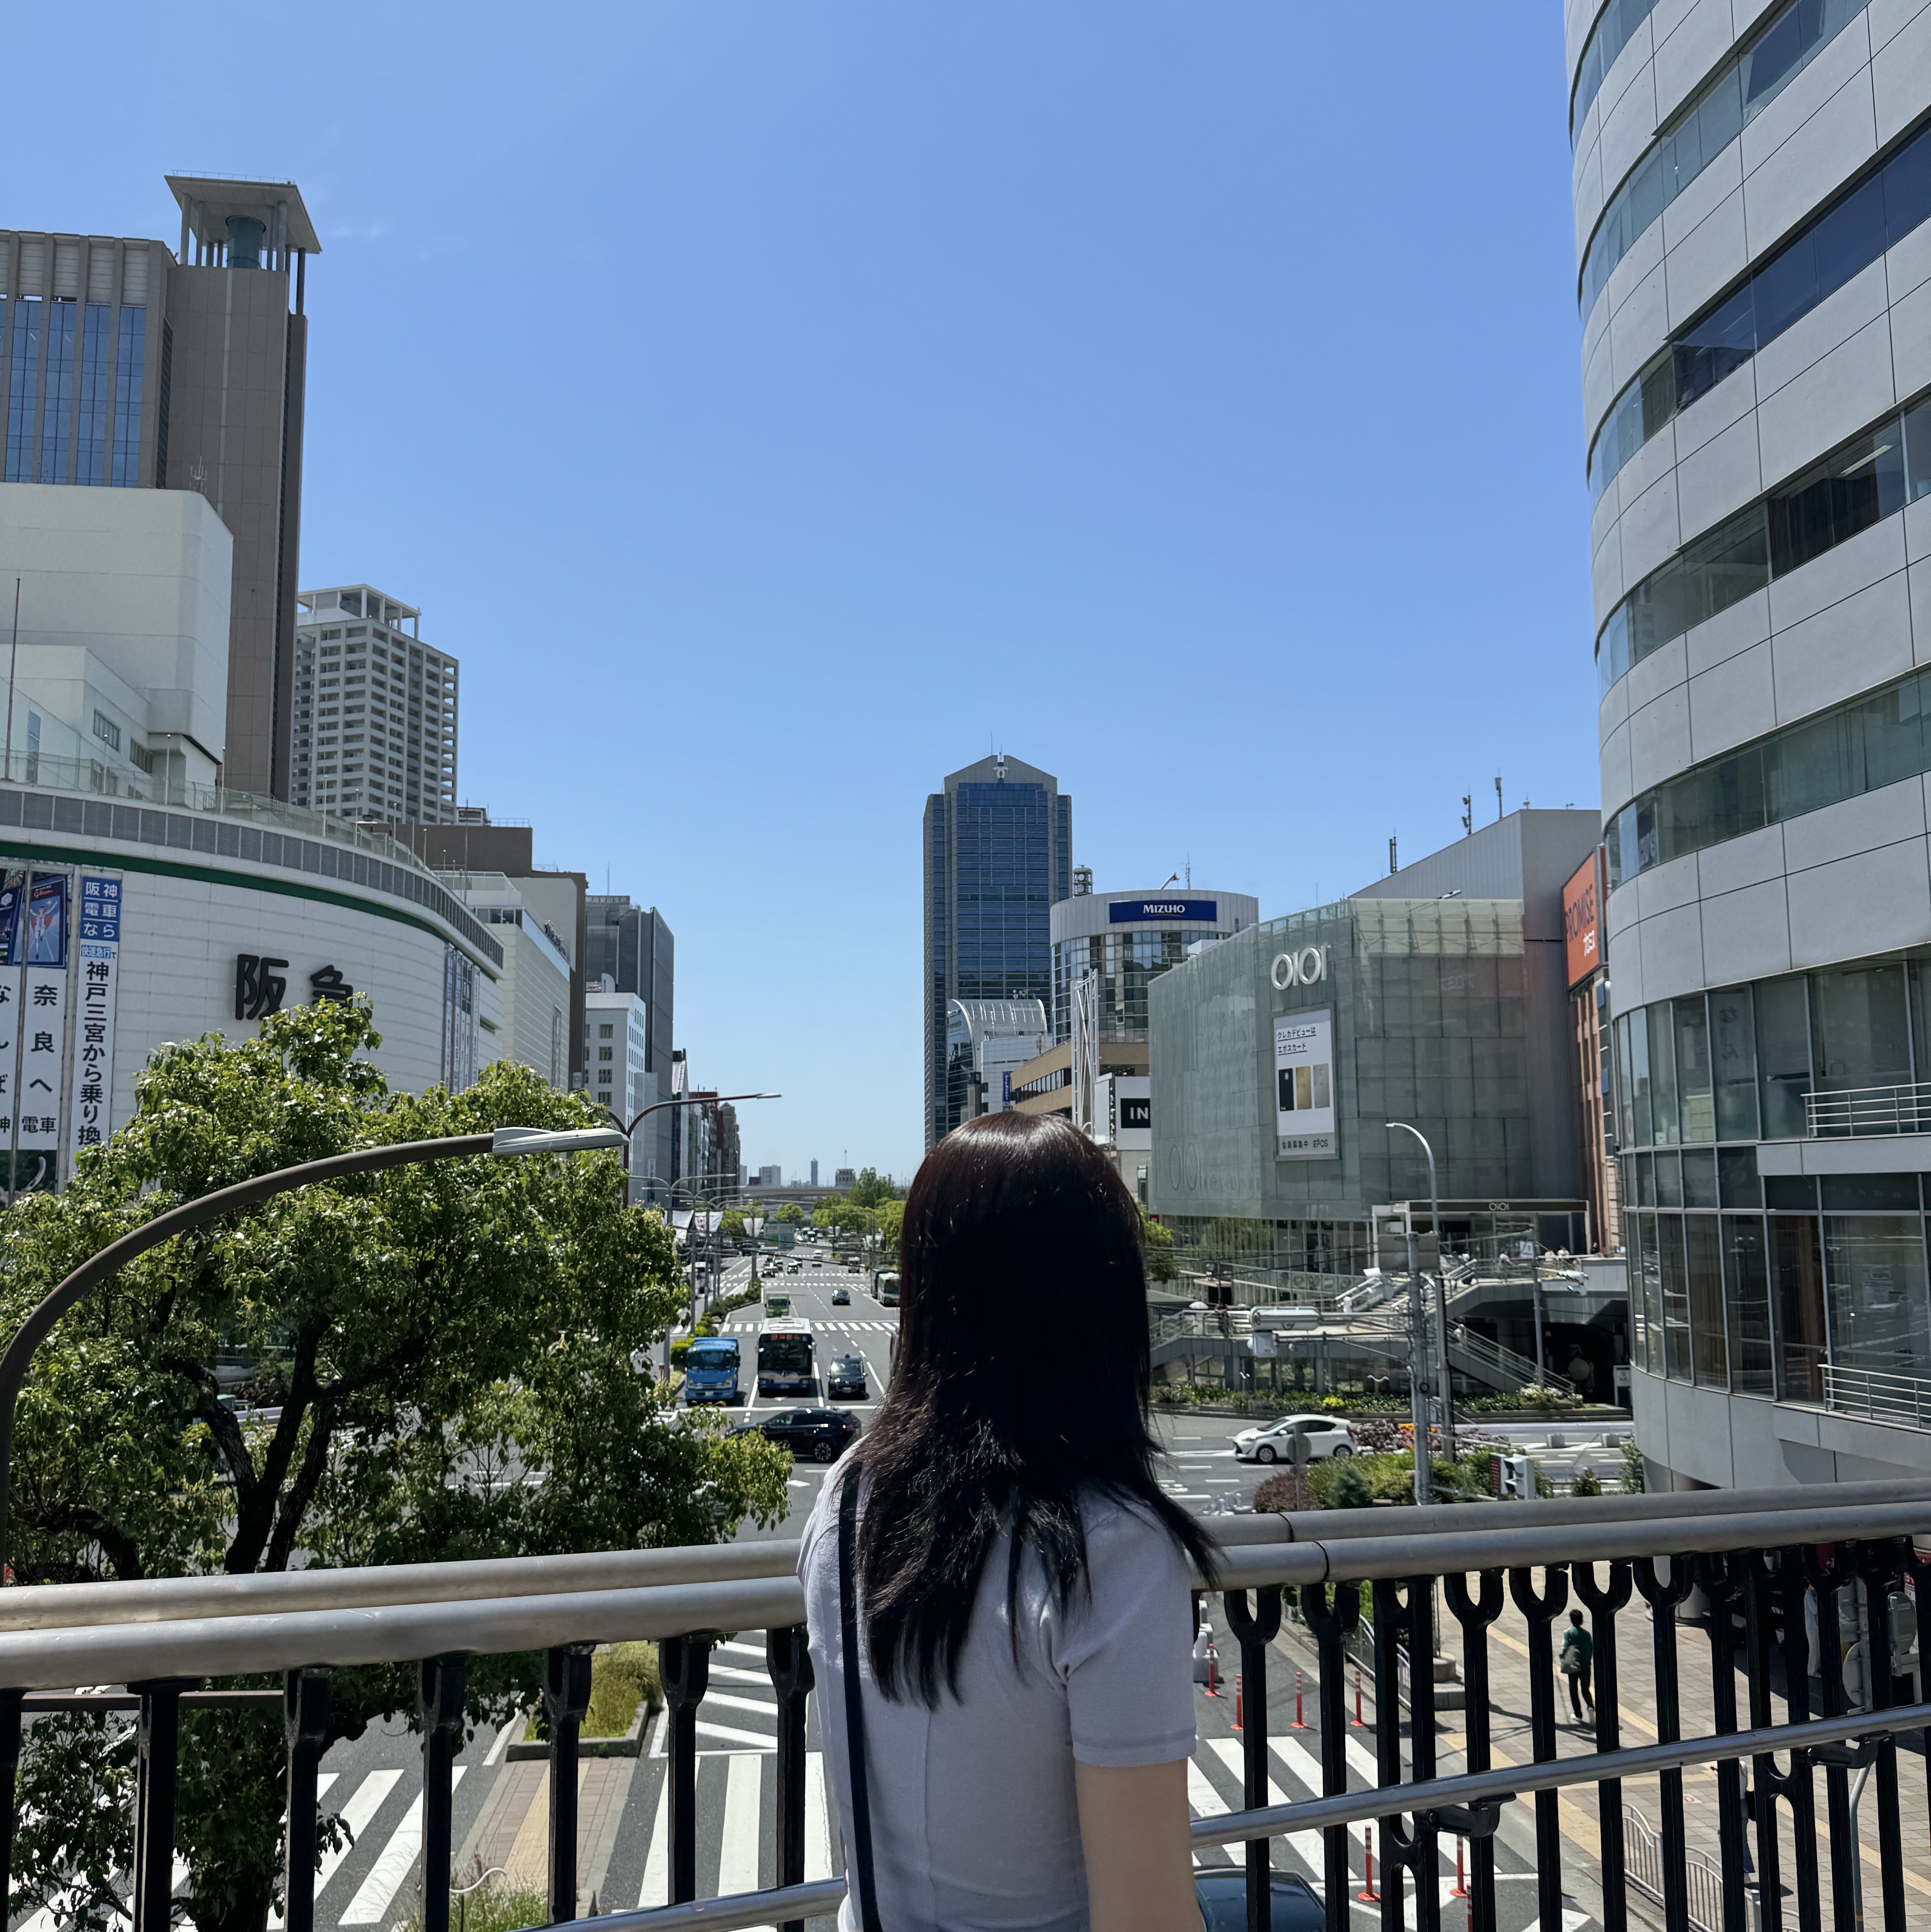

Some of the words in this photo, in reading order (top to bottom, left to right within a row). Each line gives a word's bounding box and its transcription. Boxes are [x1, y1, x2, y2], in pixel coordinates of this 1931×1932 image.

[86, 881, 117, 898] 阪神
[84, 902, 117, 918] 電車
[1143, 904, 1185, 913] MIZUHO
[84, 922, 115, 938] なら
[29, 985, 58, 1093] 奈良へ
[1278, 1026, 1316, 1039] クレカデビューは
[1278, 1042, 1306, 1053] エポスカード
[1130, 1107, 1149, 1120] IN
